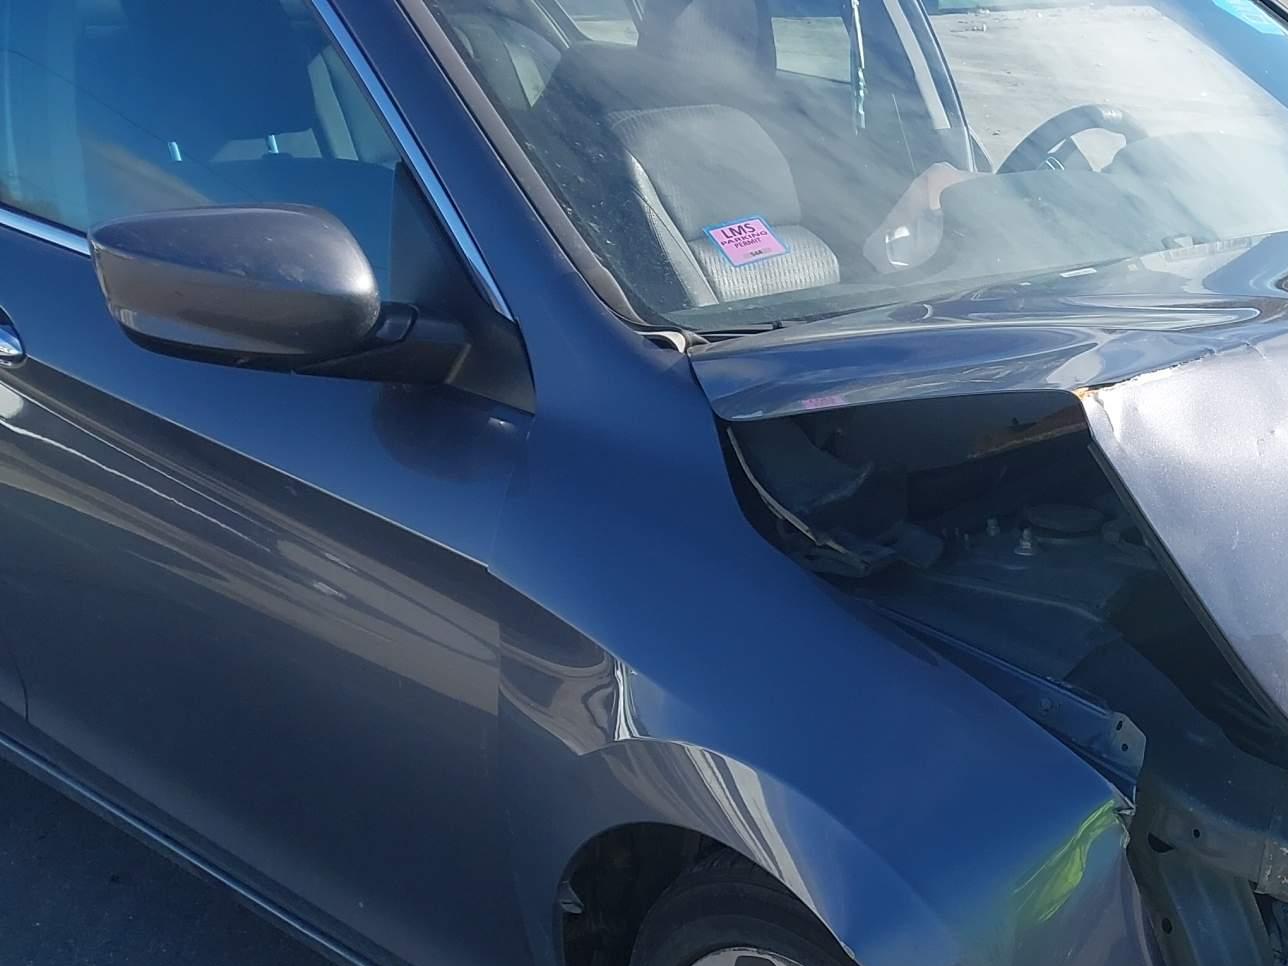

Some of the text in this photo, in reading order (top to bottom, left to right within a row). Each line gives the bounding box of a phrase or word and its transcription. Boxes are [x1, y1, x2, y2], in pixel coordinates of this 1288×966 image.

[720, 230, 768, 246] PARKING
[721, 223, 756, 239] LMS
[734, 237, 762, 249] PERMIT
